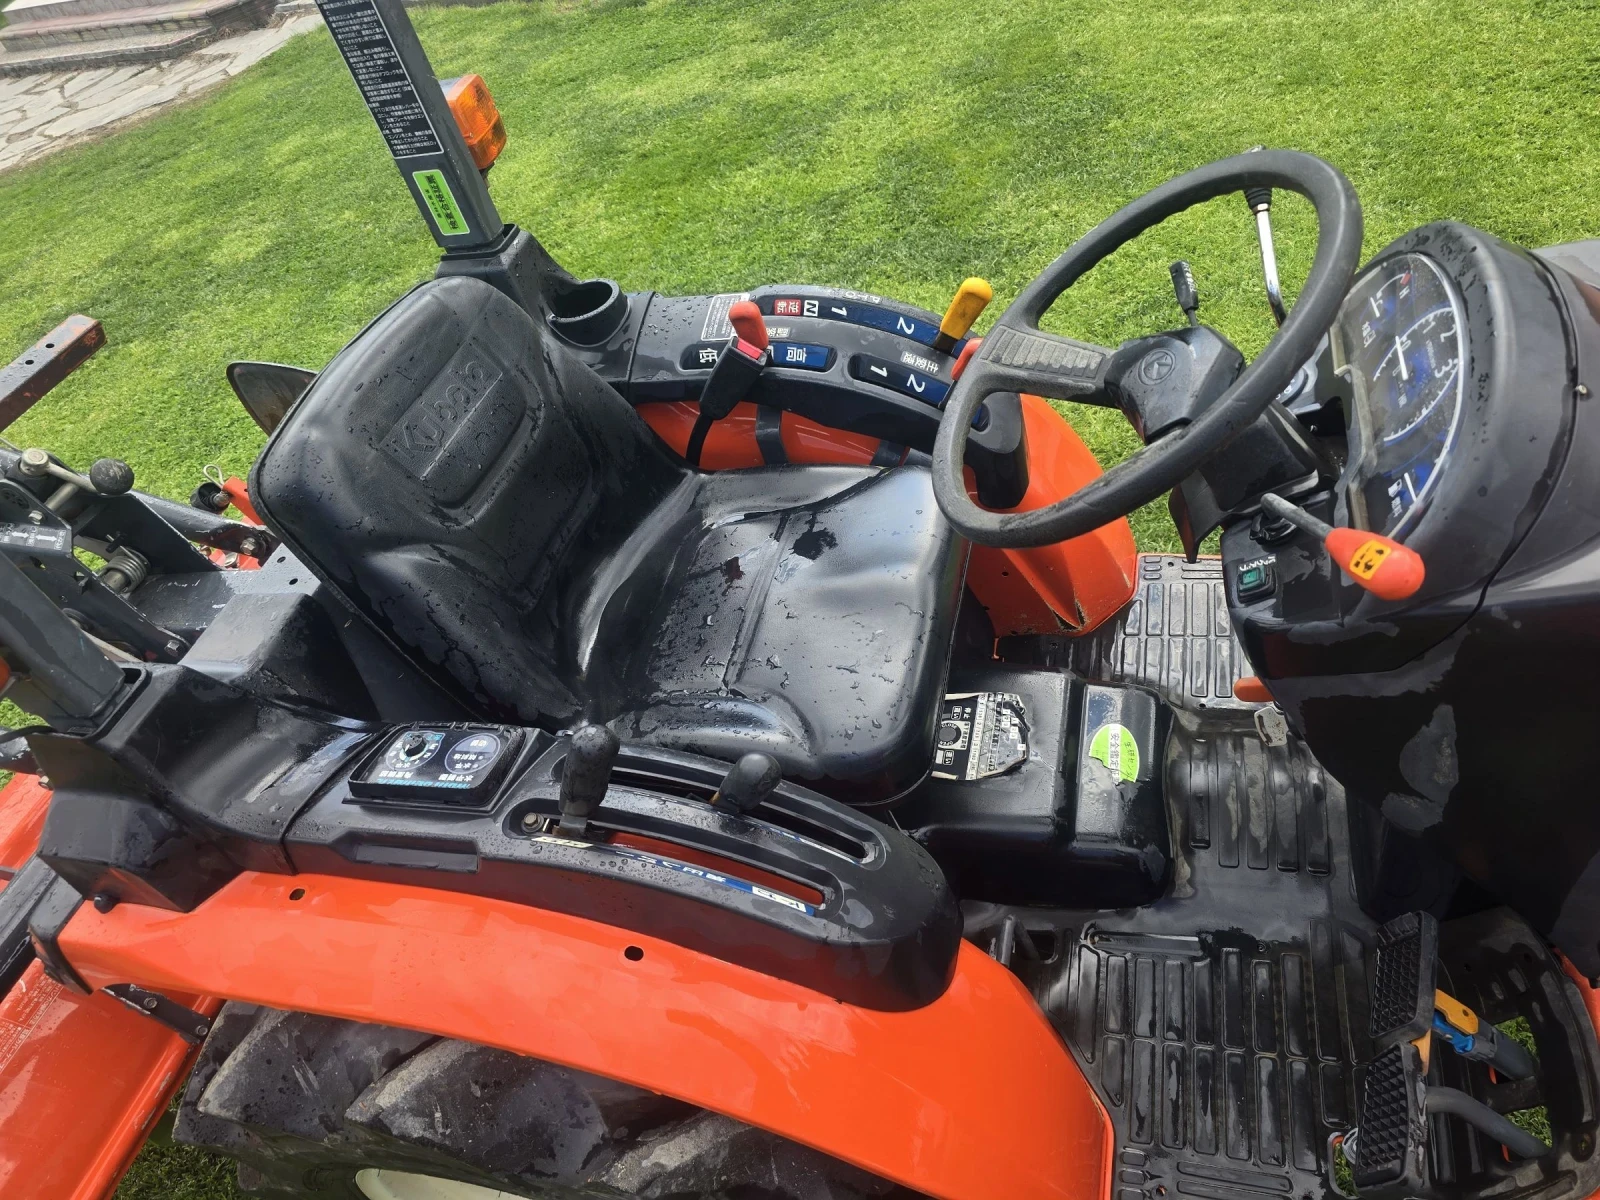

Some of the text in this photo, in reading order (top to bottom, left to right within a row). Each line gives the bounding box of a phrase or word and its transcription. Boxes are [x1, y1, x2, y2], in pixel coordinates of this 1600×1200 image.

[805, 303, 818, 315] N
[831, 306, 848, 317] 1
[897, 317, 915, 335] 2
[1440, 324, 1456, 342] 2
[786, 346, 807, 364] 高
[870, 365, 888, 378] 1
[1435, 358, 1453, 379] 3
[907, 374, 925, 393] 2
